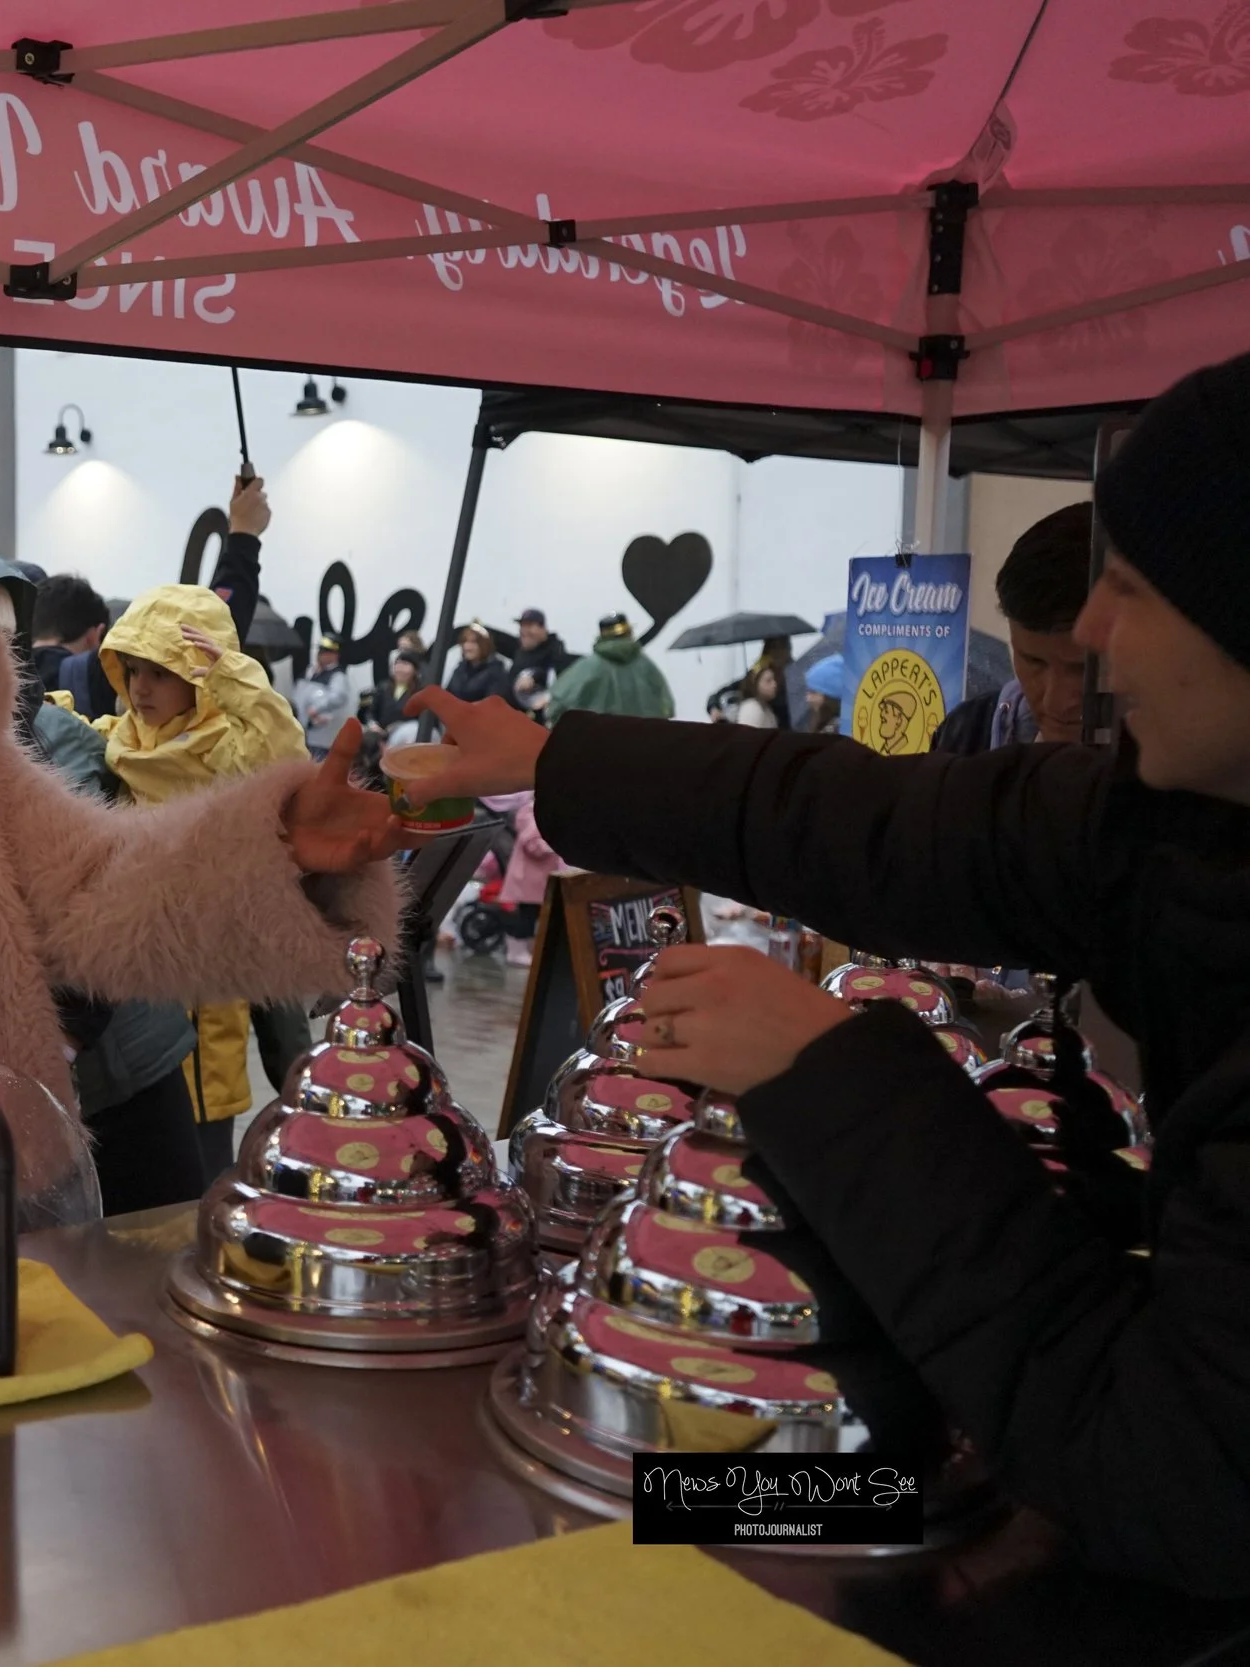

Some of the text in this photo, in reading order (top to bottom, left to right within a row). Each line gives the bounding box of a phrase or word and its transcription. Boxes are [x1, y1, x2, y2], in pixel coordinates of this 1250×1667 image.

[852, 571, 963, 617] Ice Cream
[858, 623, 951, 638] COMPLIMENTS OF
[862, 657, 937, 707] LAPPERT'S
[609, 898, 654, 947] MEN
